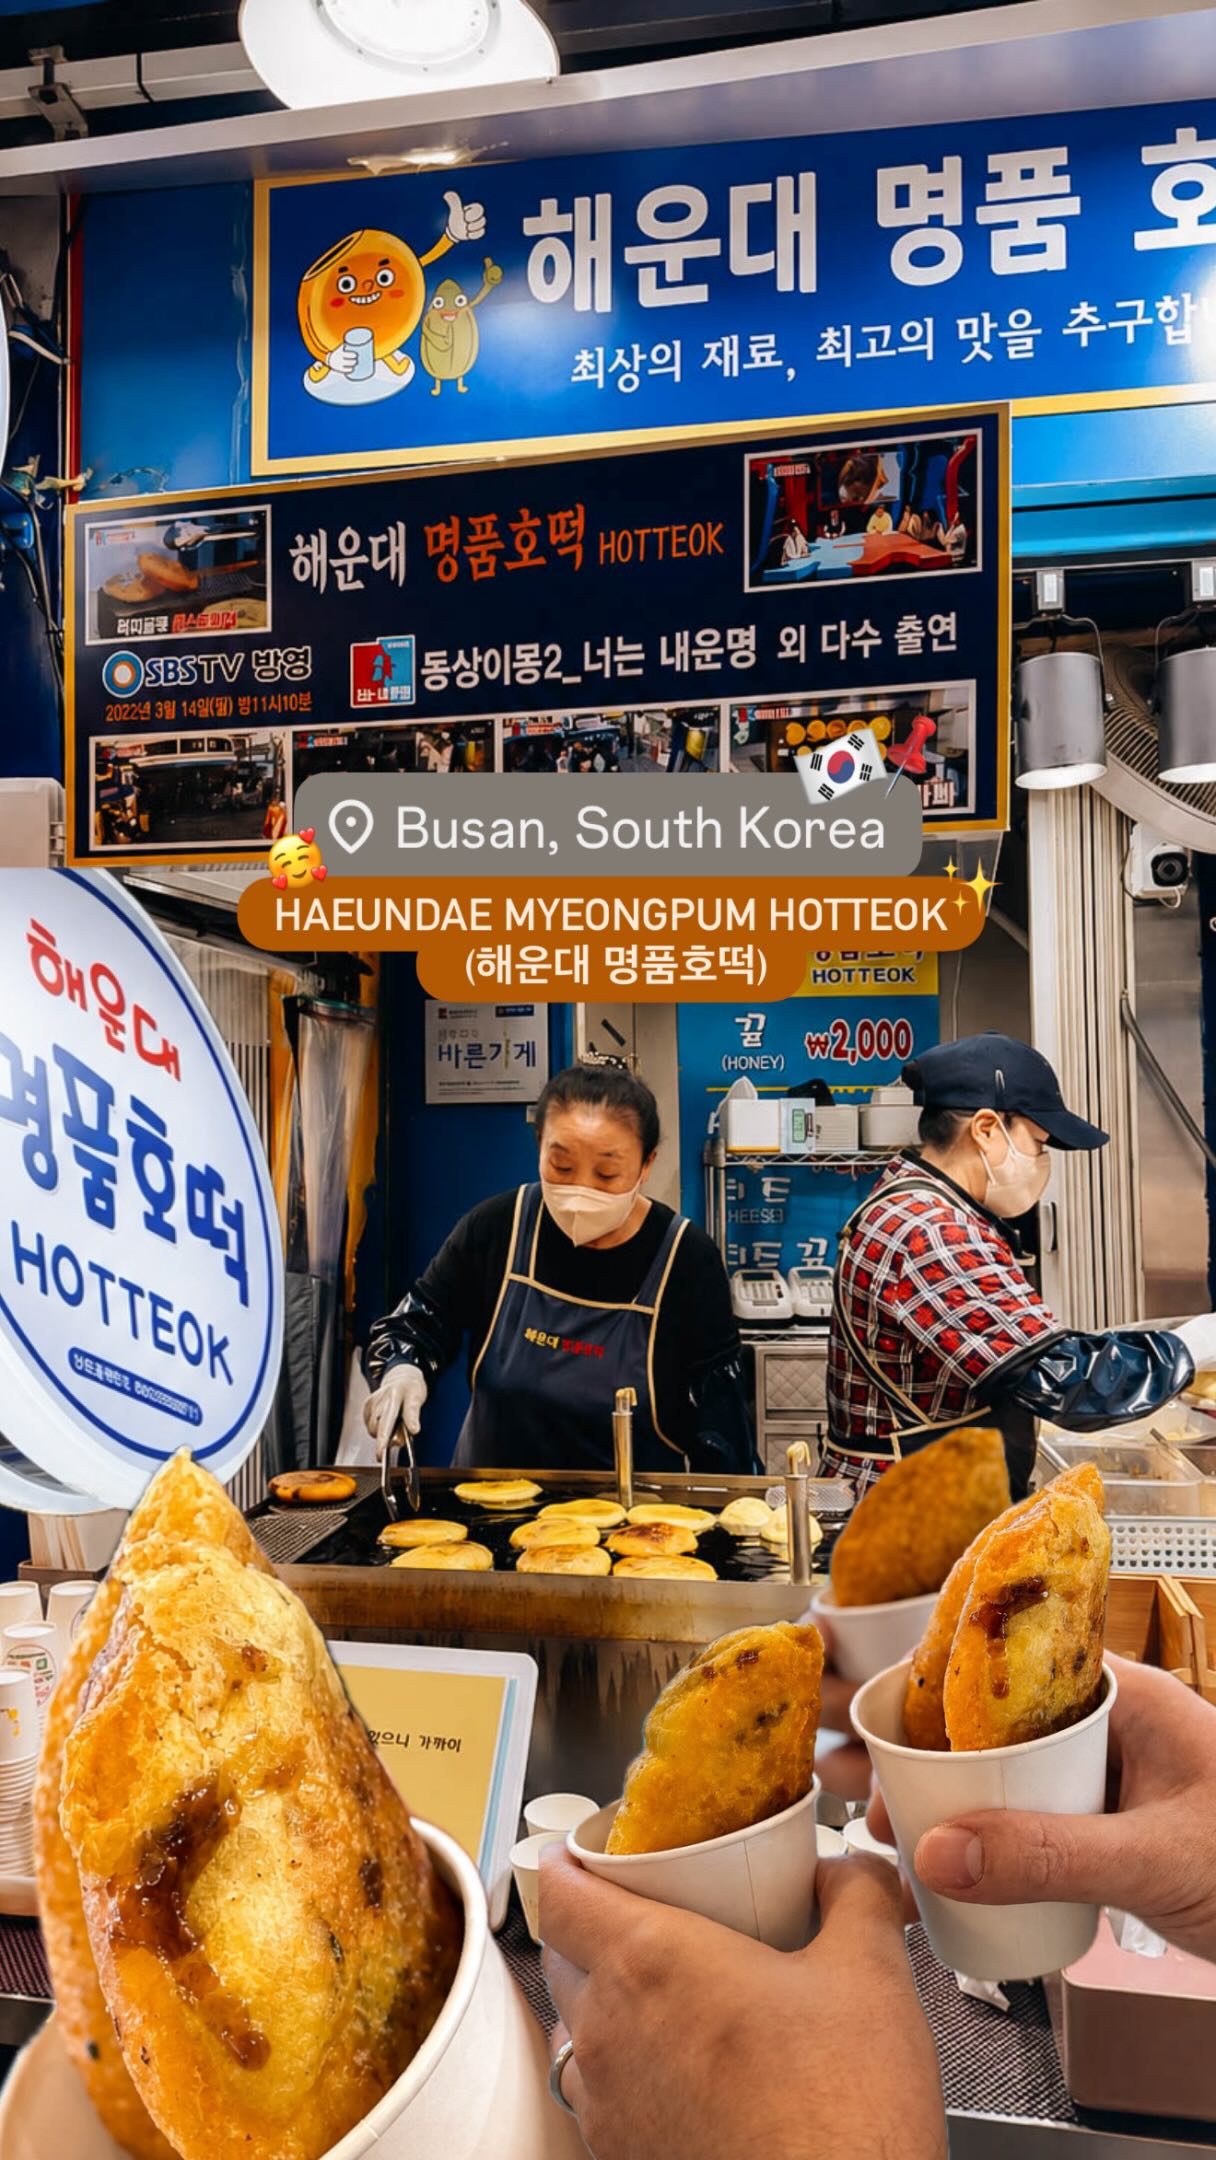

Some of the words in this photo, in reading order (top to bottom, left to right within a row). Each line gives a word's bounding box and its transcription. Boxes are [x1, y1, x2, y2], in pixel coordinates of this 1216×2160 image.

[522, 171, 818, 314] 해운대
[876, 147, 1082, 288] 명품
[1133, 126, 1216, 252] 호
[571, 340, 683, 394] 최상의
[702, 334, 797, 382] 재료,
[815, 316, 936, 369] 최고의
[956, 308, 1042, 365] 맛을
[1061, 292, 1210, 348] 추구합
[289, 520, 406, 594] 해운대
[423, 502, 585, 583] 명품호떡
[599, 521, 725, 566] HOTTEOK
[251, 645, 312, 683] 방영
[659, 624, 758, 674] 내운명
[776, 624, 807, 664] 외
[820, 618, 883, 661] 다수
[893, 611, 958, 656] 출연
[105, 701, 151, 722] 2022년
[26, 918, 183, 1082] 해운대
[812, 966, 916, 984] HOTTEOK
[721, 1054, 785, 1072] (HONEY)
[0, 1030, 250, 1308] 명품호떡
[11, 1219, 234, 1387] HOTTEOK
[418, 1734, 462, 1753] 가까이
